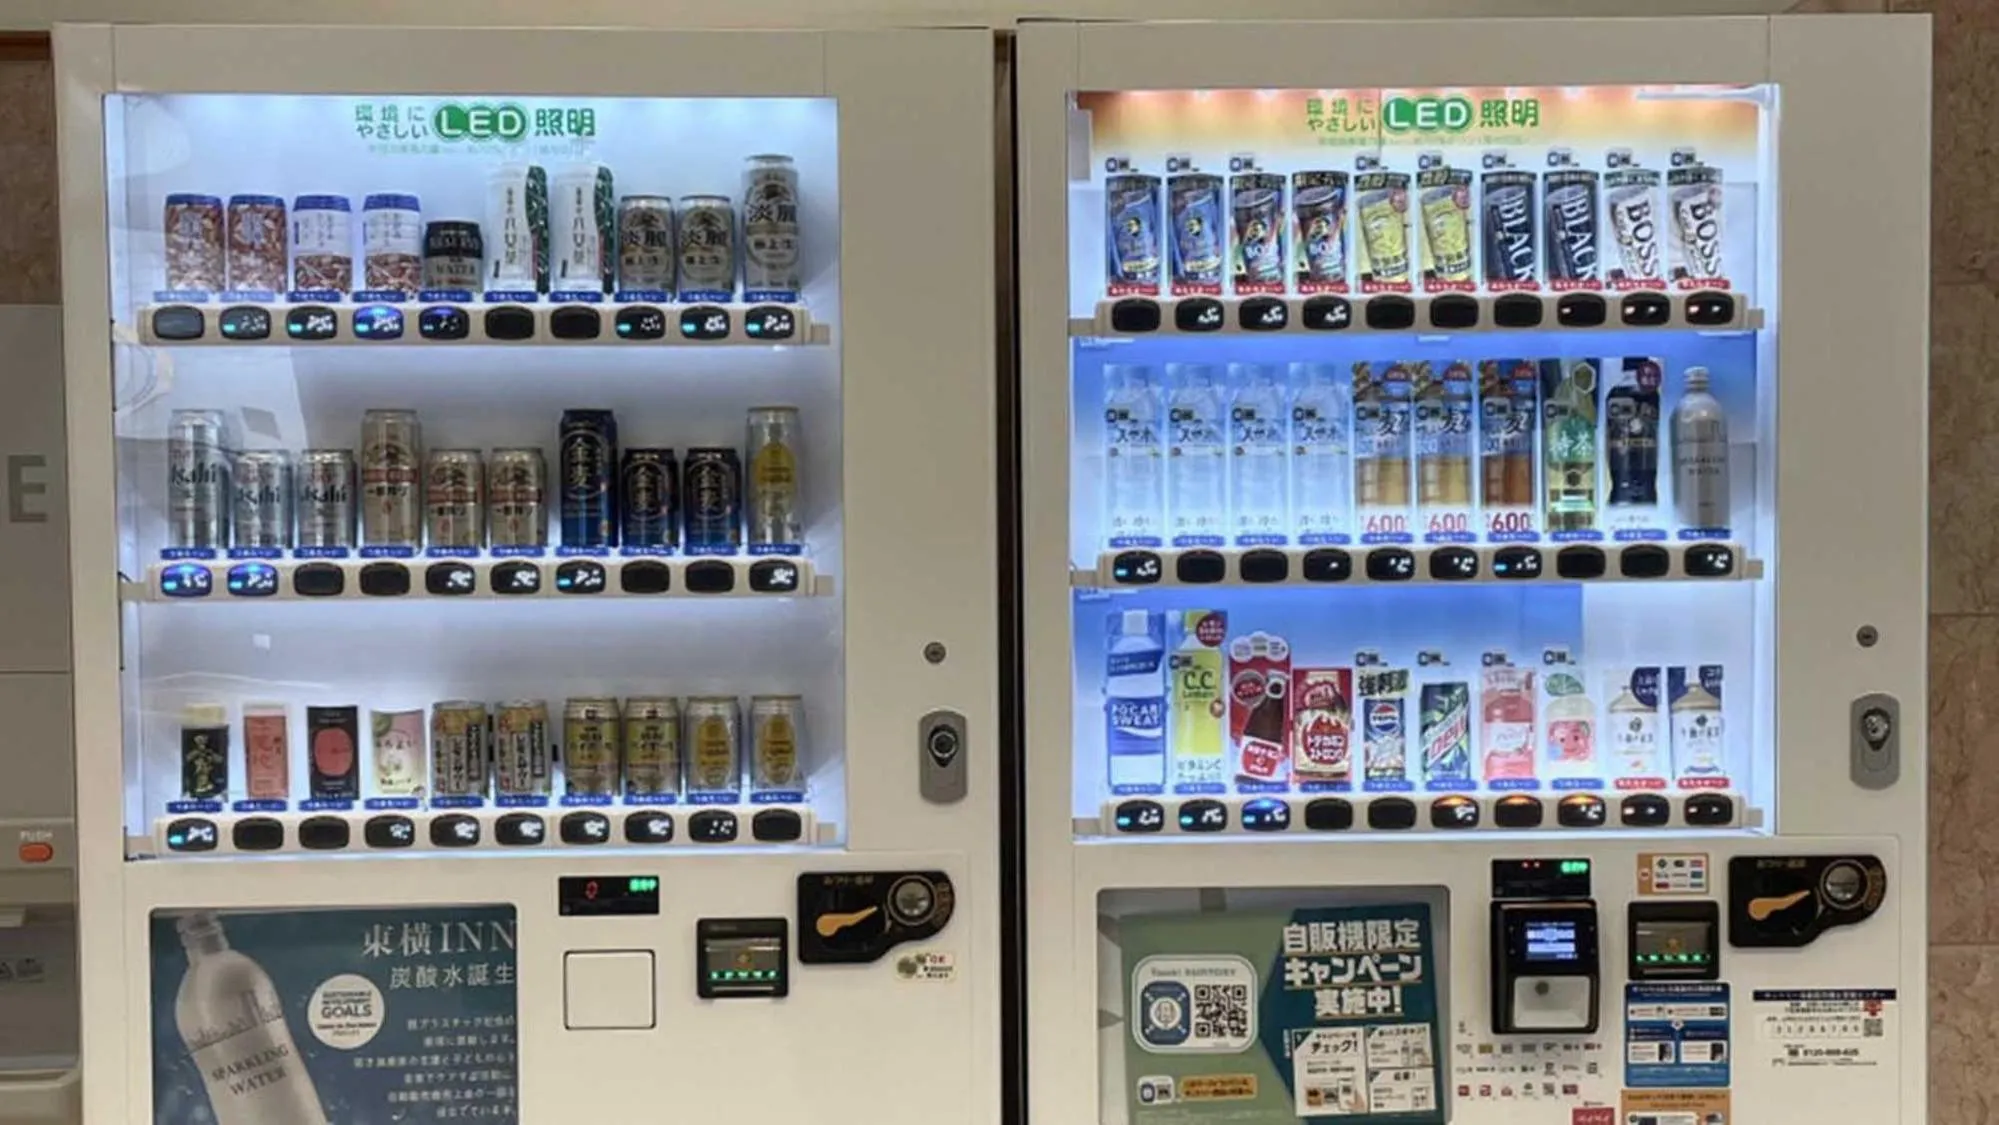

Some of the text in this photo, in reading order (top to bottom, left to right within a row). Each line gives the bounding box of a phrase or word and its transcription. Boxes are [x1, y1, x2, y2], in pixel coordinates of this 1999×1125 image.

[355, 105, 425, 122] 環境に
[1306, 98, 1373, 115] 環境に
[1388, 99, 1539, 128] LED 照明
[355, 123, 428, 140] やさしい
[440, 107, 596, 137] LED 照明
[1306, 117, 1377, 132] やさしい
[1626, 200, 1660, 276] BOSS
[8, 456, 48, 523] E
[1366, 515, 1405, 533] 600
[1428, 513, 1467, 533] 600
[1492, 512, 1531, 532] 600
[362, 921, 516, 958] 東横INN
[1282, 919, 1421, 954] 自販機限定
[389, 963, 515, 991] 炭酸水誕生
[1284, 955, 1422, 987] キャンペーン
[321, 1005, 372, 1019] GOALS
[1314, 988, 1402, 1018] 実施中!
[1310, 1040, 1358, 1055] チェック!
[229, 1065, 287, 1095] WATER
